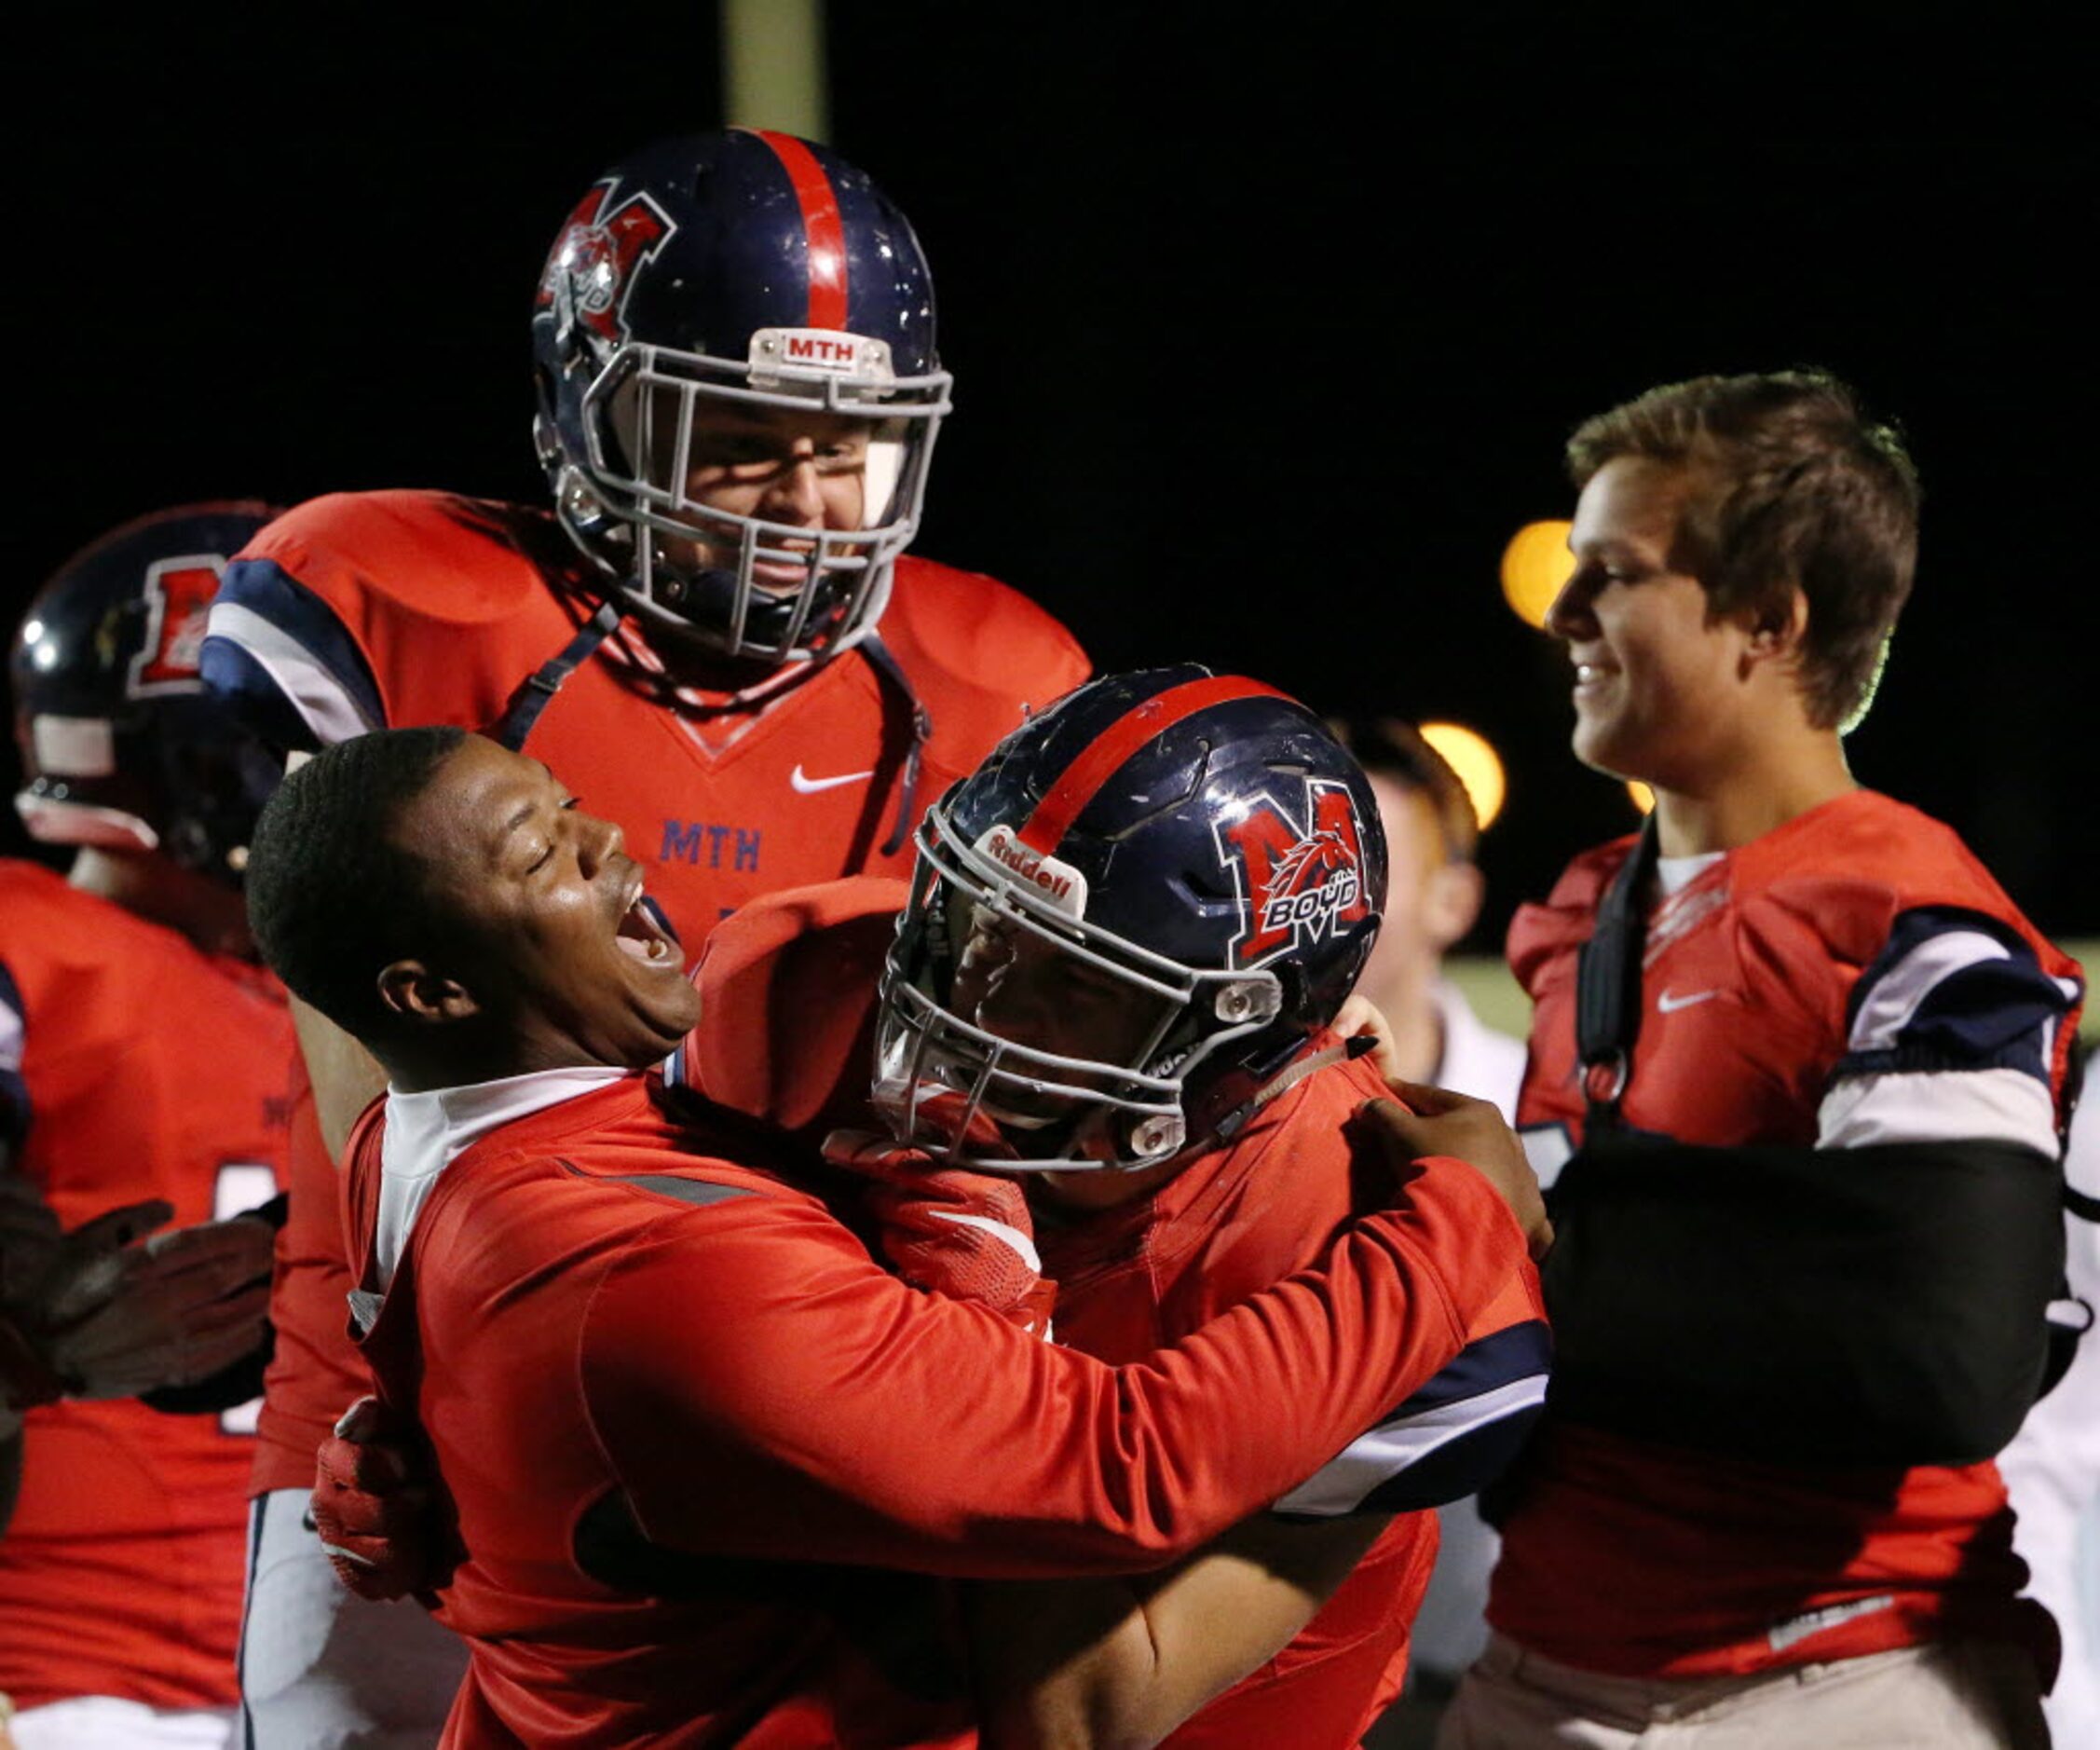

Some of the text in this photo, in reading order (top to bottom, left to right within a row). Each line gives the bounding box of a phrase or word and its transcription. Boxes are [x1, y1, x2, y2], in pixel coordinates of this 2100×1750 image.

[789, 337, 852, 361] MTH
[660, 819, 760, 872] MTH
[988, 833, 1072, 901] Riddell
[1261, 879, 1358, 931] BOYD
